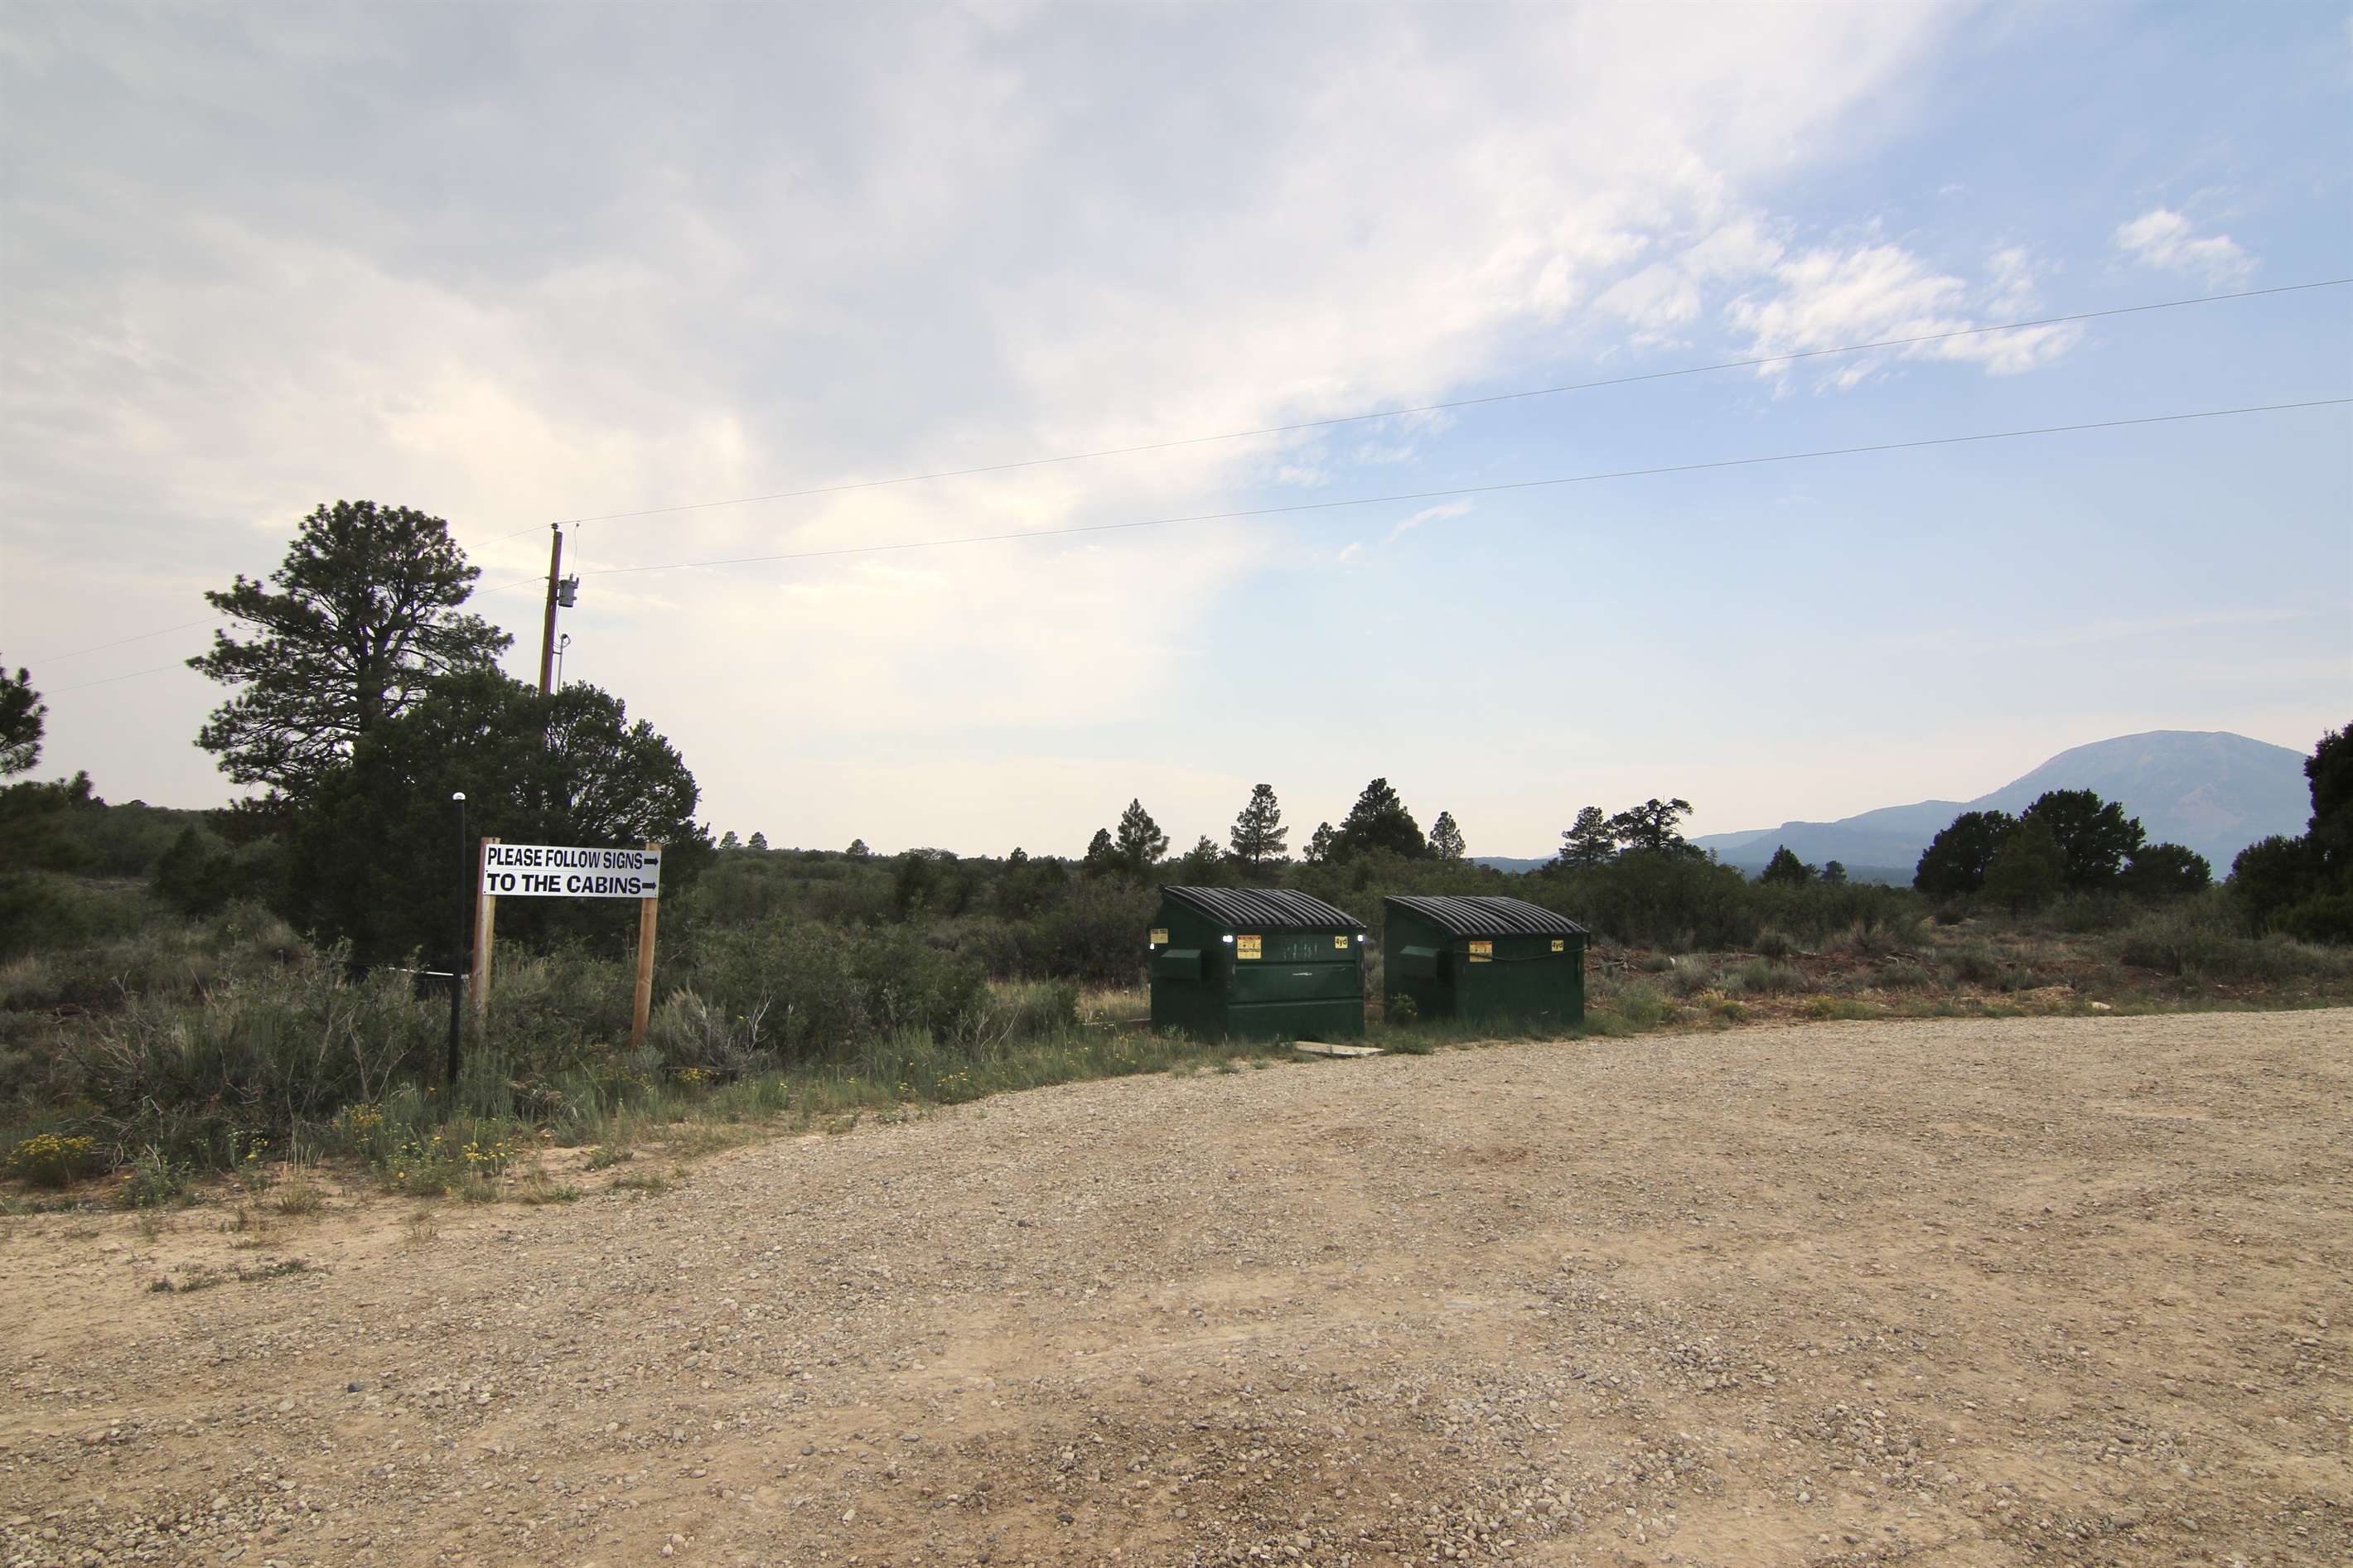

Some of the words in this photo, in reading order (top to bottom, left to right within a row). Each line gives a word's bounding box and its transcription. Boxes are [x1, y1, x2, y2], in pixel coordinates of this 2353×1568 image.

[488, 847, 543, 866] PLEASE
[545, 850, 601, 868] FOLLOW
[603, 852, 643, 870] SIGNS
[487, 873, 516, 891] TO
[521, 874, 561, 892] THE
[567, 875, 641, 895] CABINS
[1336, 938, 1347, 946] 4yd
